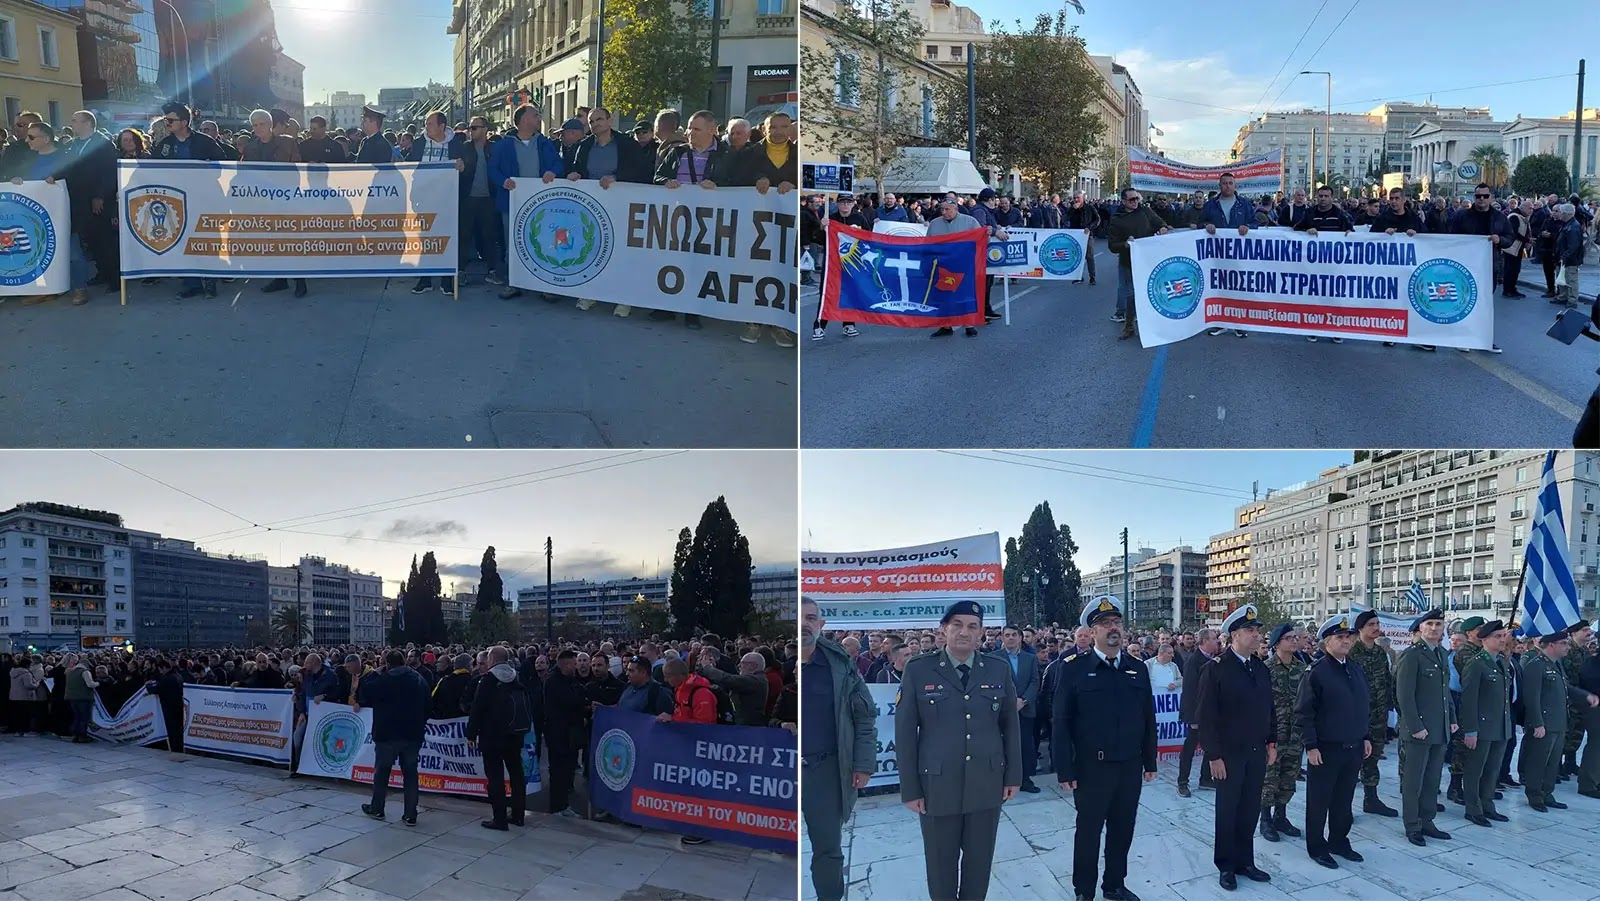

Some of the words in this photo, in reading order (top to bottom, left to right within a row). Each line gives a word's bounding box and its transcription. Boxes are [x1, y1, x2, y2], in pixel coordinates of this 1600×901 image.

[231, 186, 291, 200] Σύλλογος
[293, 186, 363, 200] Αποφοίτων
[367, 185, 399, 198] ΣΤΥΑ
[201, 216, 225, 230] Στις
[228, 216, 272, 230] σχολές
[274, 220, 297, 230] μας
[300, 216, 345, 229] μάθαμε
[348, 216, 378, 230] ήθος
[380, 218, 398, 228] και
[626, 202, 738, 258] ΕΝΩΣΗ
[750, 210, 798, 268] ΣΤ
[190, 242, 208, 251] και
[211, 240, 275, 255] παίρνουμε
[278, 240, 353, 254] υποβάθμιση
[356, 242, 374, 254] ως
[377, 239, 442, 253] ανταμοιβή!
[1007, 244, 1024, 254] ΟΧΙ
[1195, 237, 1303, 262] ΠΑΝΕΛΛΑΔΙΚΗ
[1306, 240, 1418, 266] ΟΜΟΣΠΟΝΔΙΑ
[657, 265, 685, 295] Ο
[1210, 268, 1276, 294] ΕΝΩΣΕΩΝ
[1280, 272, 1398, 300] ΣΤΡΑΤΙΩΤΙΚΩΝ
[1206, 304, 1222, 317] ΟΧΙ
[1224, 307, 1246, 319] στην
[1248, 307, 1301, 324] απαξίωση
[1302, 312, 1325, 324] των
[1325, 312, 1406, 330] Στρατιωτικών
[830, 576, 872, 587] τους
[877, 568, 996, 587] στρατιωτικούς
[252, 702, 268, 711] ΣΤΥΑ
[695, 740, 764, 765] ΕΝΩΣΗ
[653, 762, 742, 792] ΠΕΡΙΦΕΡ.
[749, 775, 798, 799] ΕΝΟ
[636, 795, 703, 817] ΑΠΟΣΥΡΣΗ
[708, 806, 733, 822] ΤΟΥ
[736, 810, 797, 833] ΝΟΜΟΣΧ
